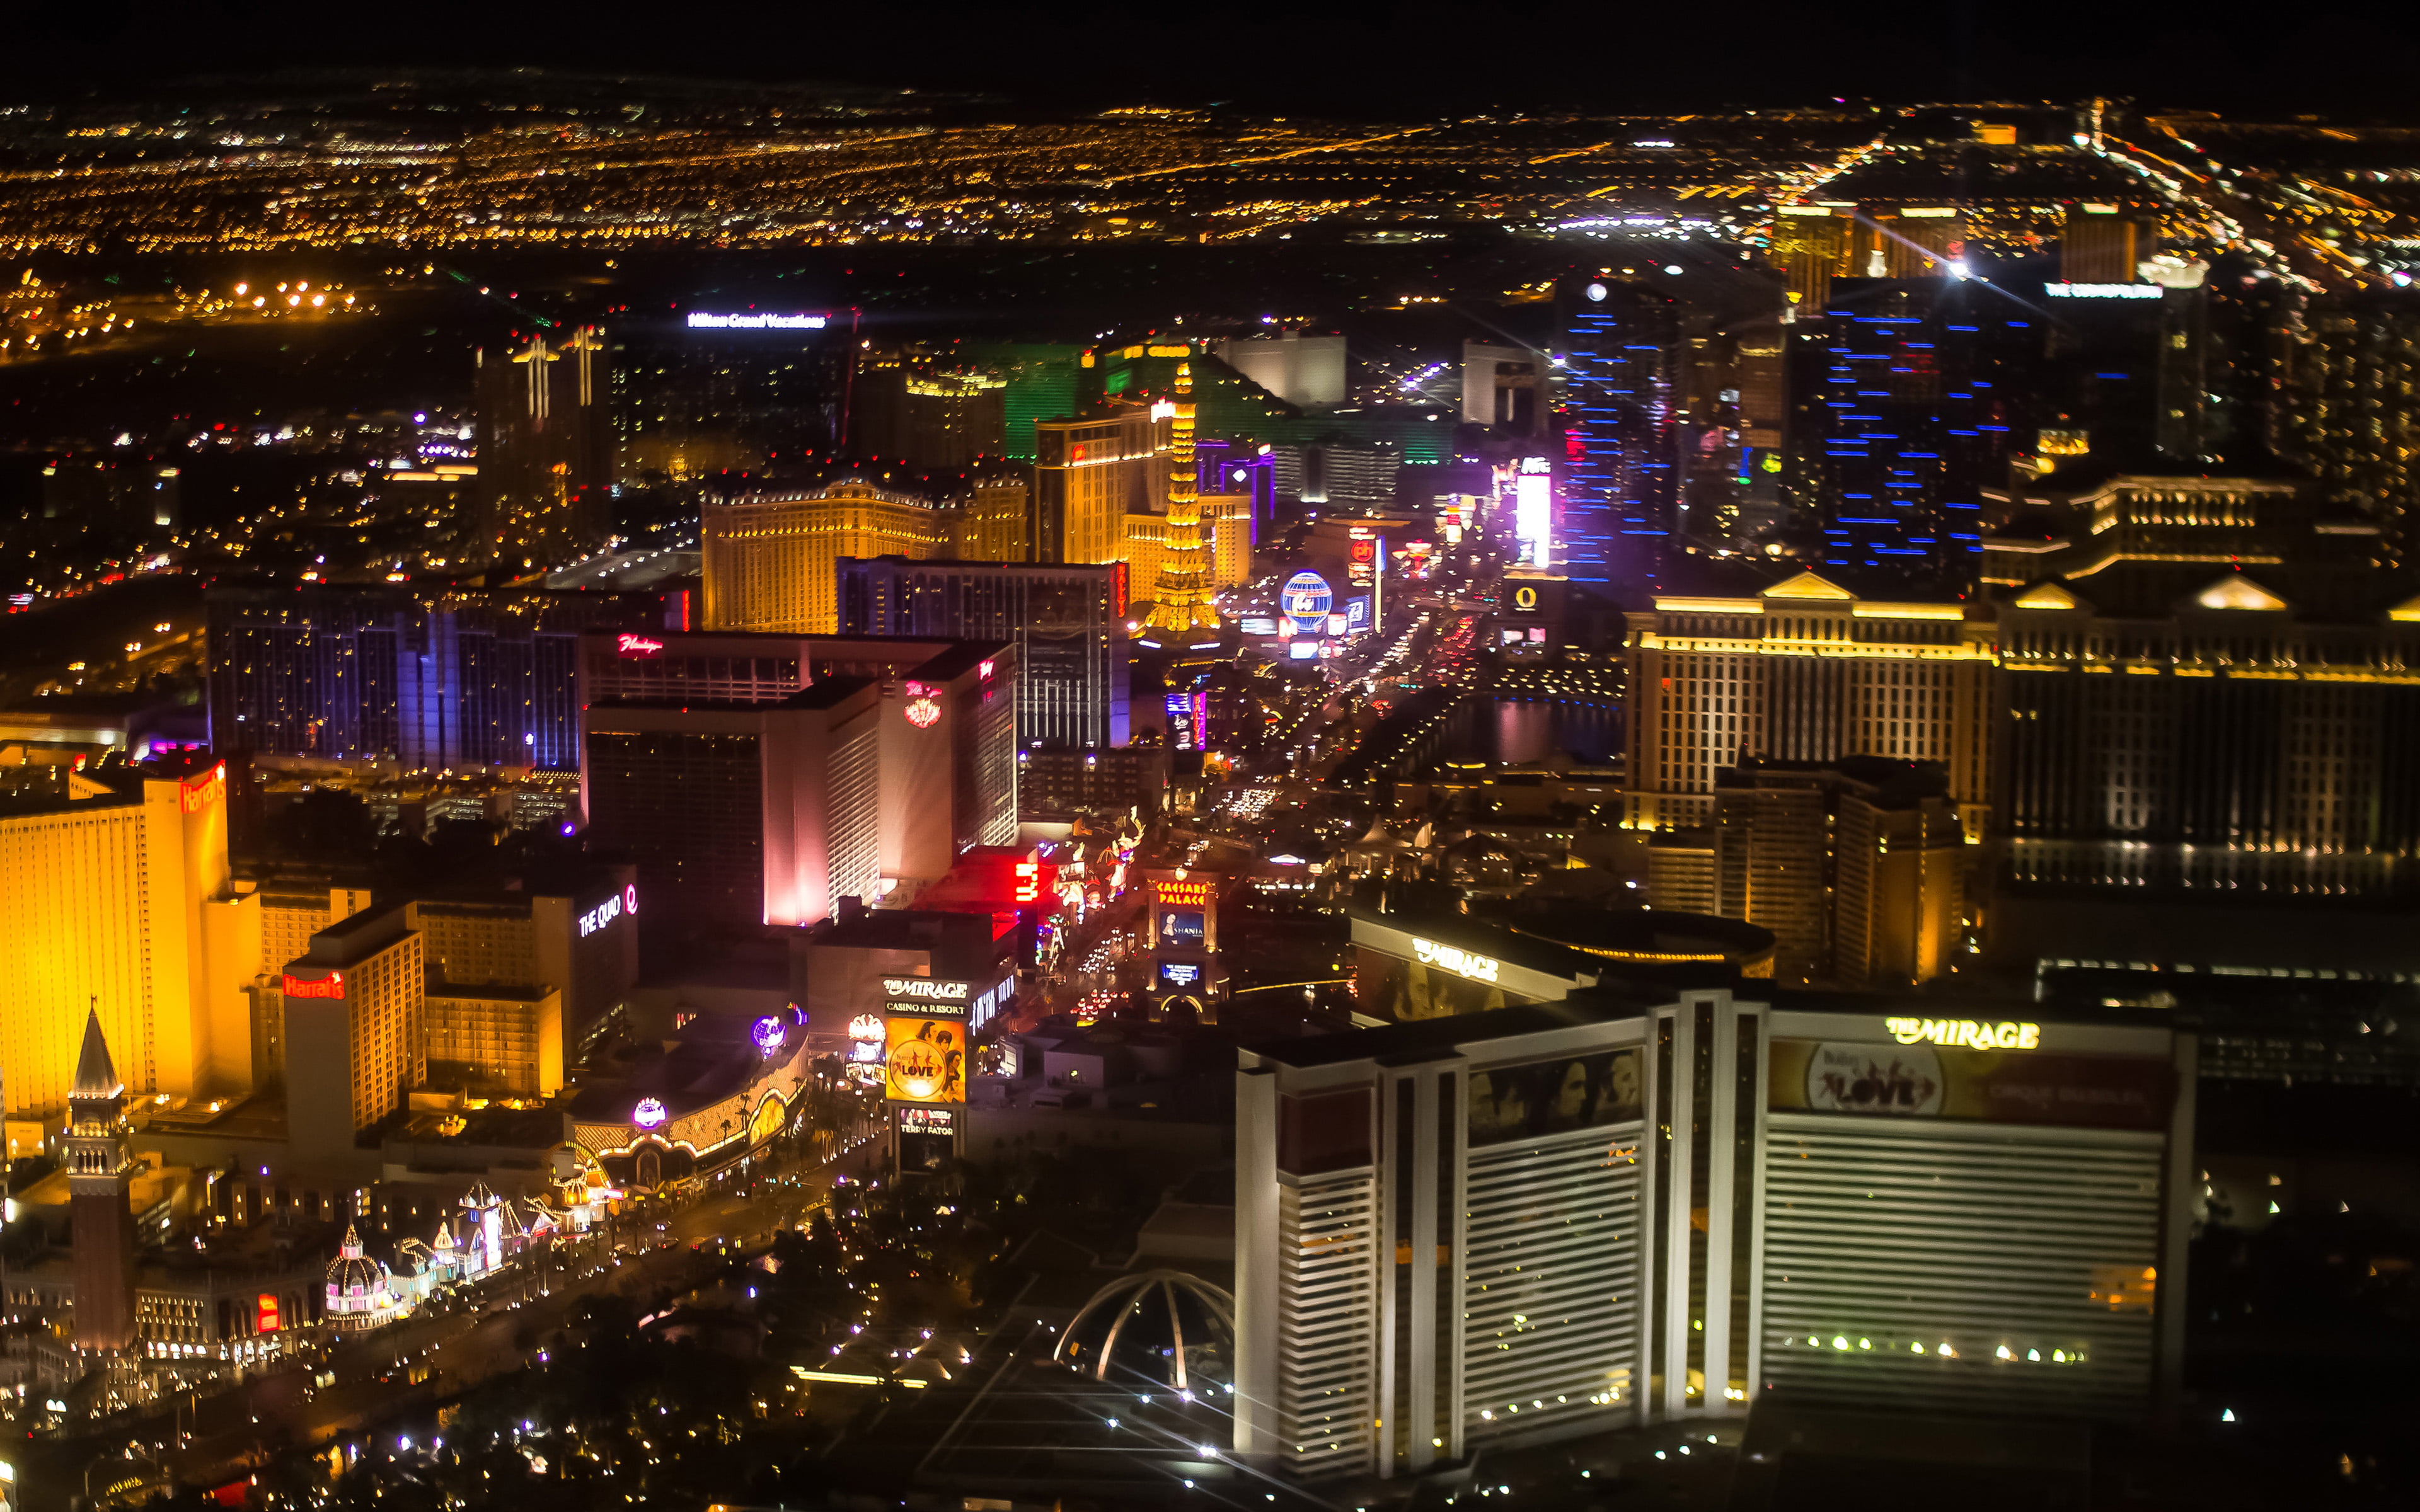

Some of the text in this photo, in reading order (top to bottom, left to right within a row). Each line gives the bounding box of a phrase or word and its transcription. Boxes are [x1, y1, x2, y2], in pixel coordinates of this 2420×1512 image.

[729, 314, 766, 328] Grand
[766, 314, 826, 328] Vacations
[1156, 881, 1207, 894] CAESARS
[1158, 893, 1205, 905] PALACE
[579, 894, 621, 938] THE QUAD
[1173, 927, 1204, 936] SHANIA
[1417, 943, 1499, 982] MIRAGE
[889, 980, 968, 999] MIRAGE
[887, 1003, 921, 1012] CASINO
[930, 1005, 965, 1014] RESORT
[1896, 1017, 2041, 1051] MIRAGE
[901, 1065, 933, 1077] LOVE
[1836, 1077, 1915, 1105] LOVE
[901, 1124, 954, 1136] TERRY FATOR
